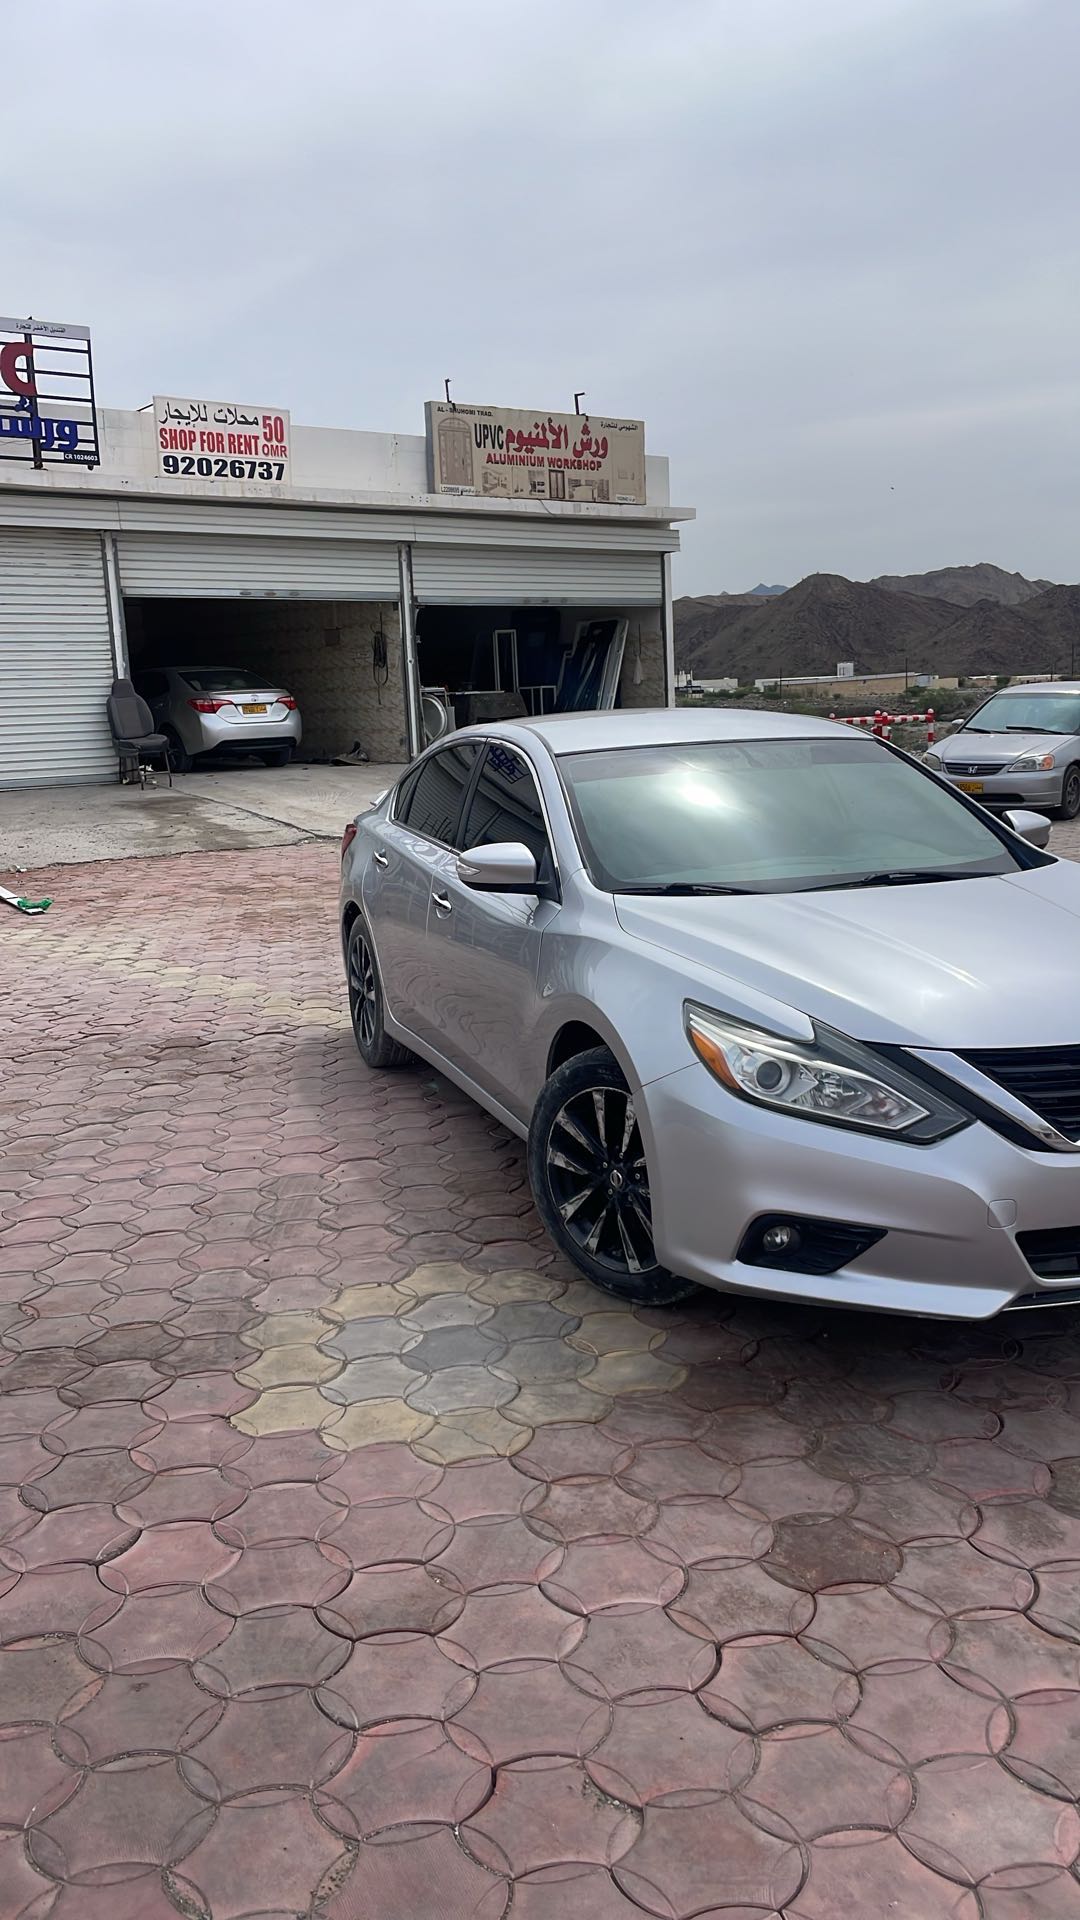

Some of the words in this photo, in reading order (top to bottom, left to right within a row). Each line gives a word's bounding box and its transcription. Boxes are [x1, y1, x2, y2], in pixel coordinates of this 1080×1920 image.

[158, 401, 208, 428] للإيجار
[213, 407, 259, 426] محلات
[159, 427, 196, 451] SHOP
[200, 431, 225, 454] FOR
[228, 433, 260, 456] RENT
[262, 415, 285, 443] 50
[474, 422, 504, 450] UPVC
[572, 422, 608, 459] ورش
[261, 443, 288, 458] OMR
[486, 453, 545, 468] ALUMINIUM
[547, 457, 602, 471] WORKSHOP
[162, 455, 285, 481] 92026737
